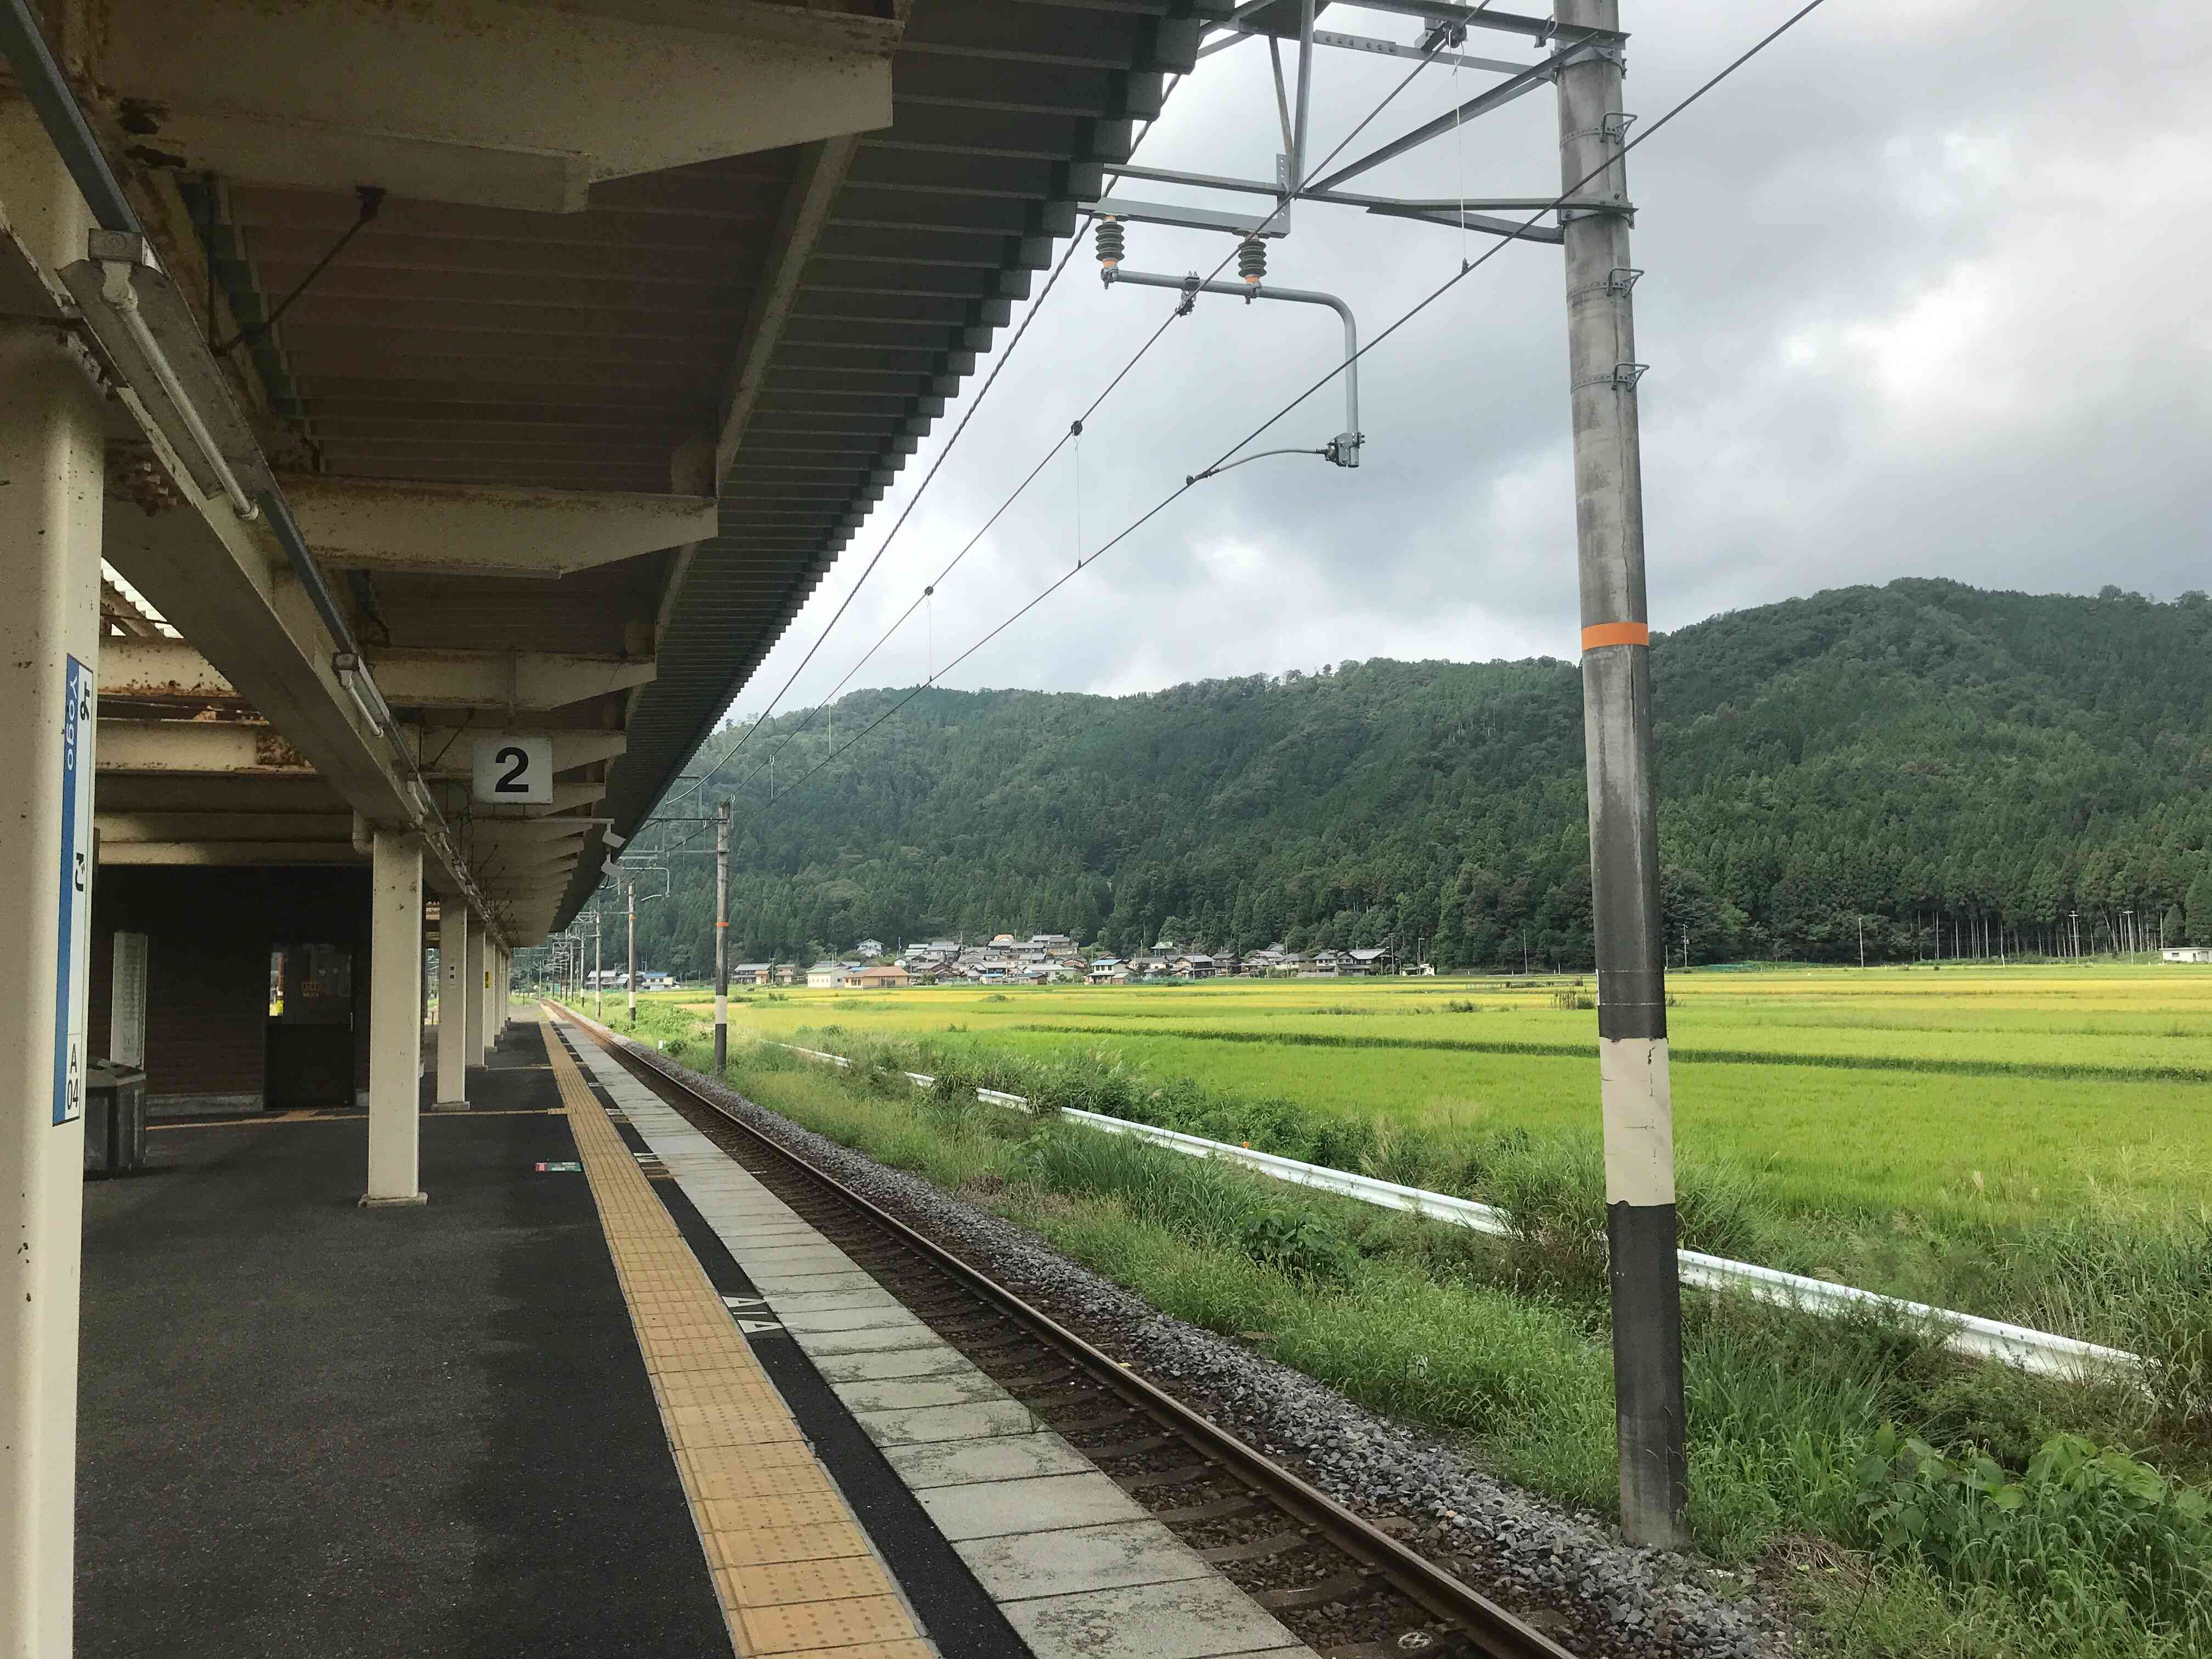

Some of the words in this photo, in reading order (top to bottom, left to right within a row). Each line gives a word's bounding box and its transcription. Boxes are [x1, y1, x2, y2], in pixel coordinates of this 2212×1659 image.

[66, 675, 78, 771] Yogo
[75, 681, 90, 891] よご
[495, 747, 529, 792] 2
[70, 1043, 77, 1074] A
[67, 1079, 79, 1110] 04
